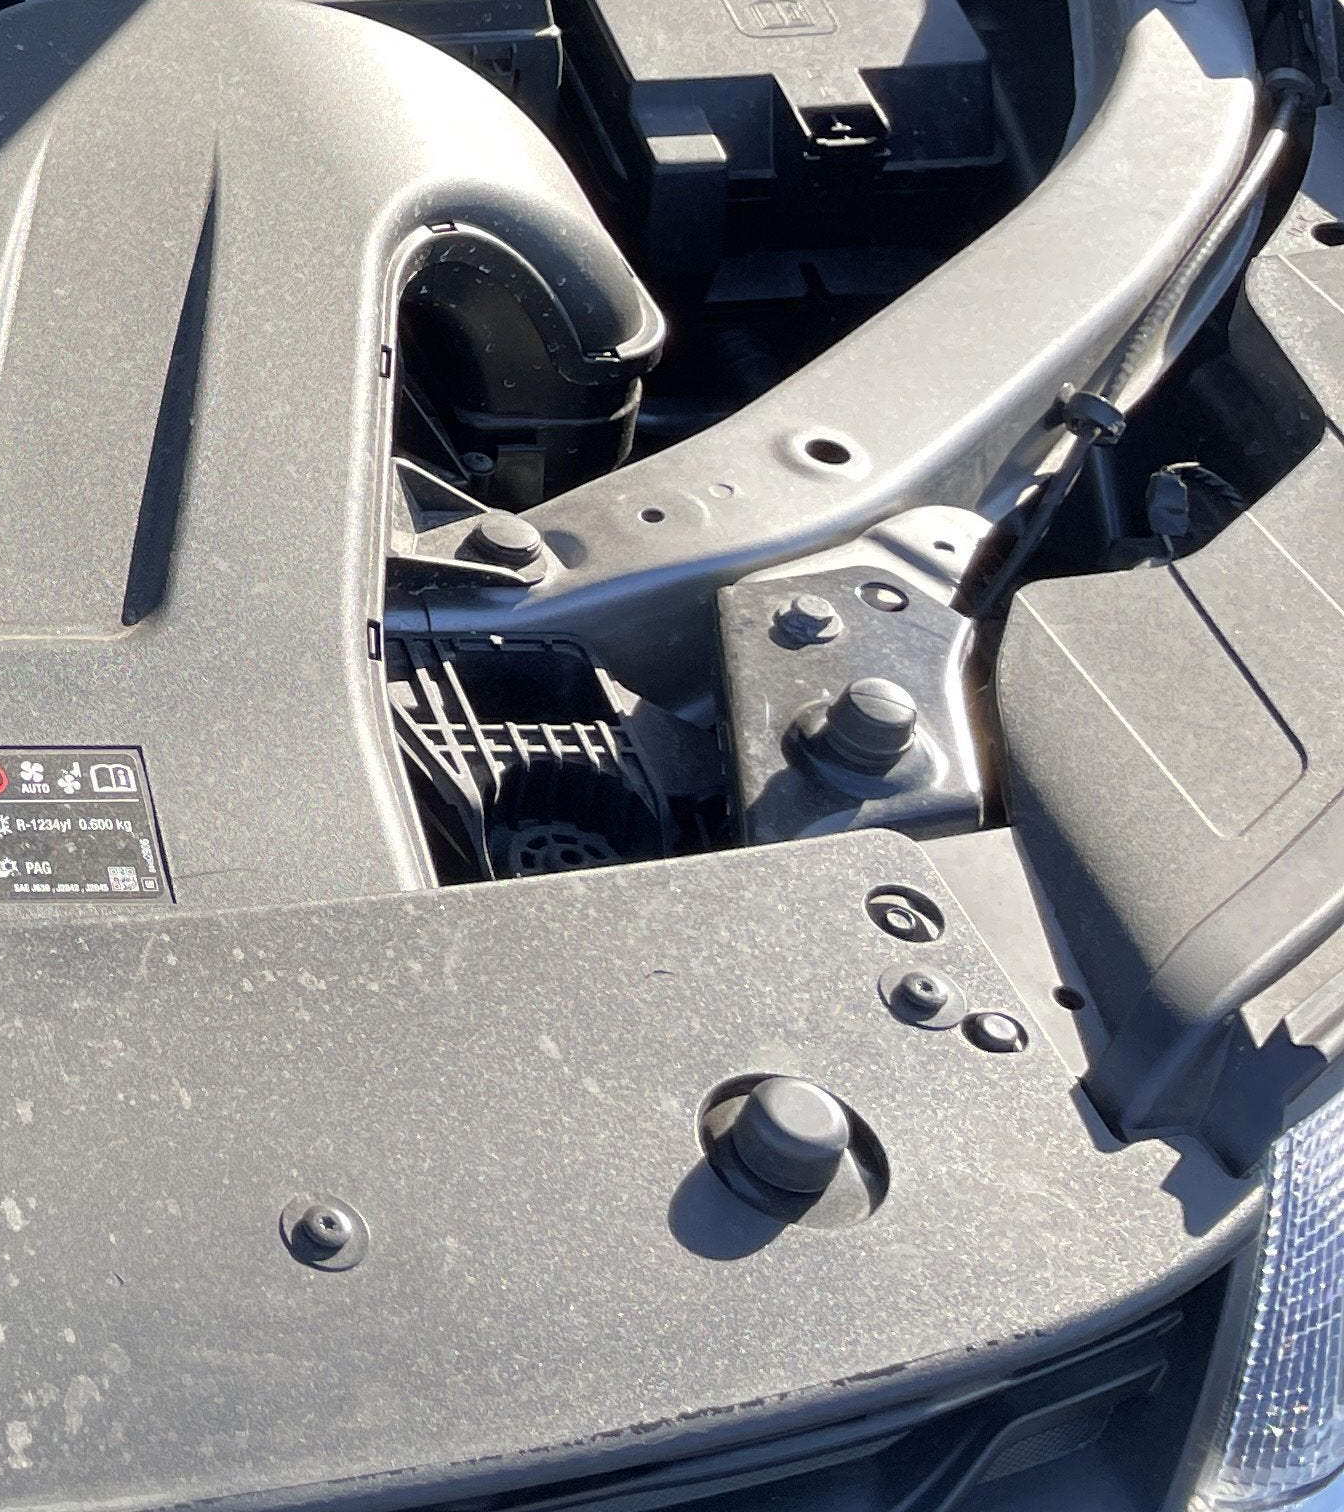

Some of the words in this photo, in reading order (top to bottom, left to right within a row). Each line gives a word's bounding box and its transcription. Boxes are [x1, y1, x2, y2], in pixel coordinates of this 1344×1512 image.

[21, 783, 51, 794] AUTO
[78, 818, 114, 831] 0.600
[115, 818, 133, 833] kg
[25, 861, 53, 875] PAG
